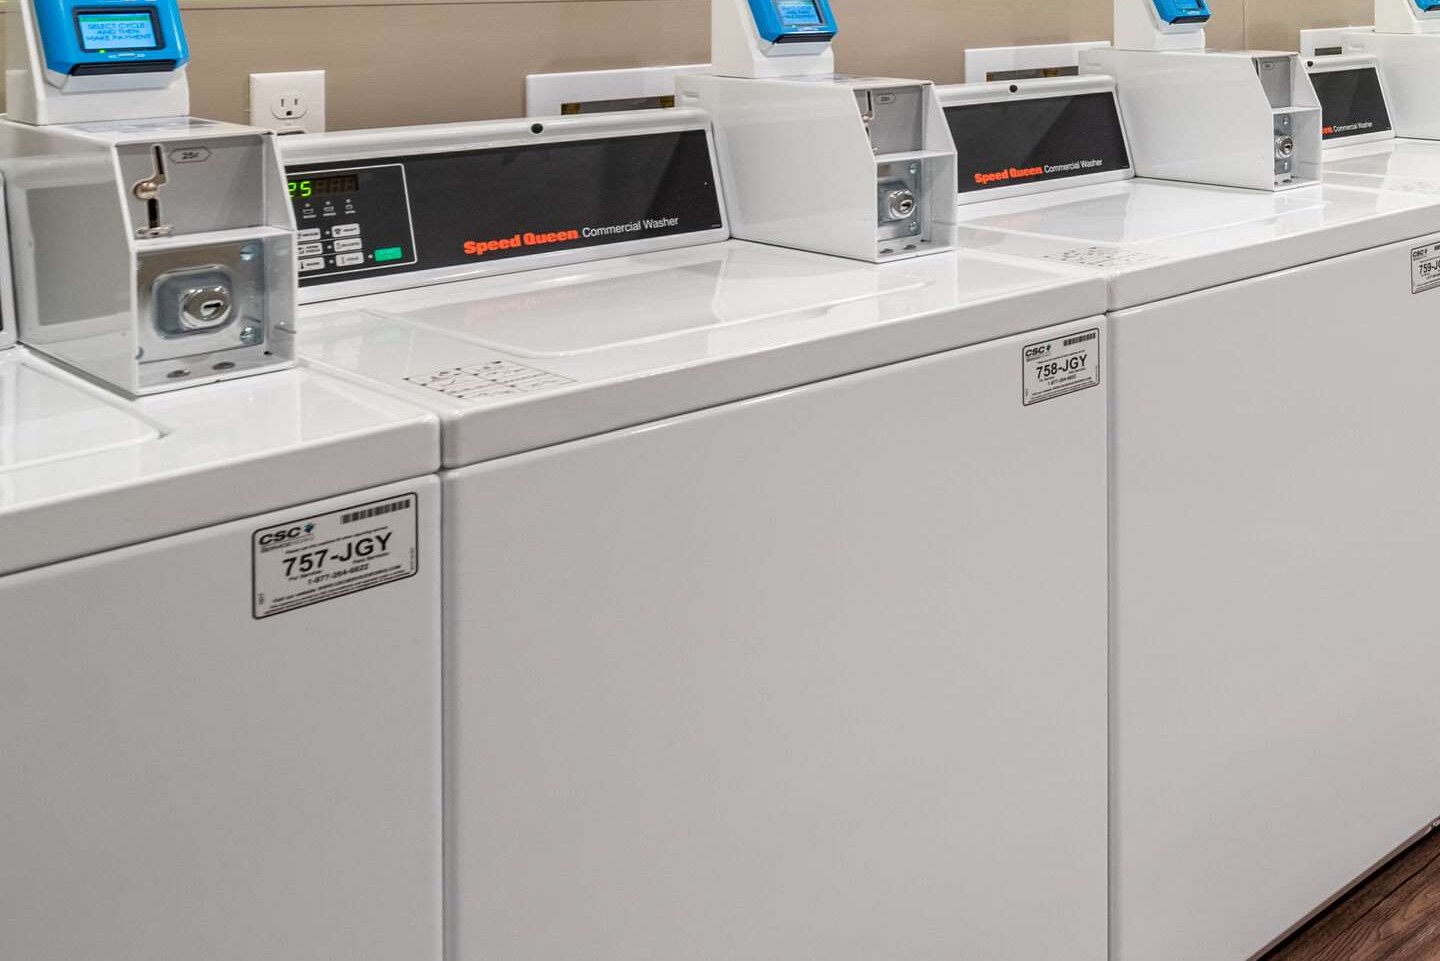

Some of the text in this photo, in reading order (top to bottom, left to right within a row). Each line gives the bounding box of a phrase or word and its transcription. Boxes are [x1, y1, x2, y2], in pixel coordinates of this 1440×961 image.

[974, 158, 1103, 184] Speed Queen Commercial Washer
[464, 216, 679, 255] Speed Queen Commercial Washer
[1025, 346, 1045, 357] CSC
[1036, 354, 1088, 380] 758-JGY
[258, 526, 302, 546] CSC
[282, 532, 392, 577] 757-JGY
